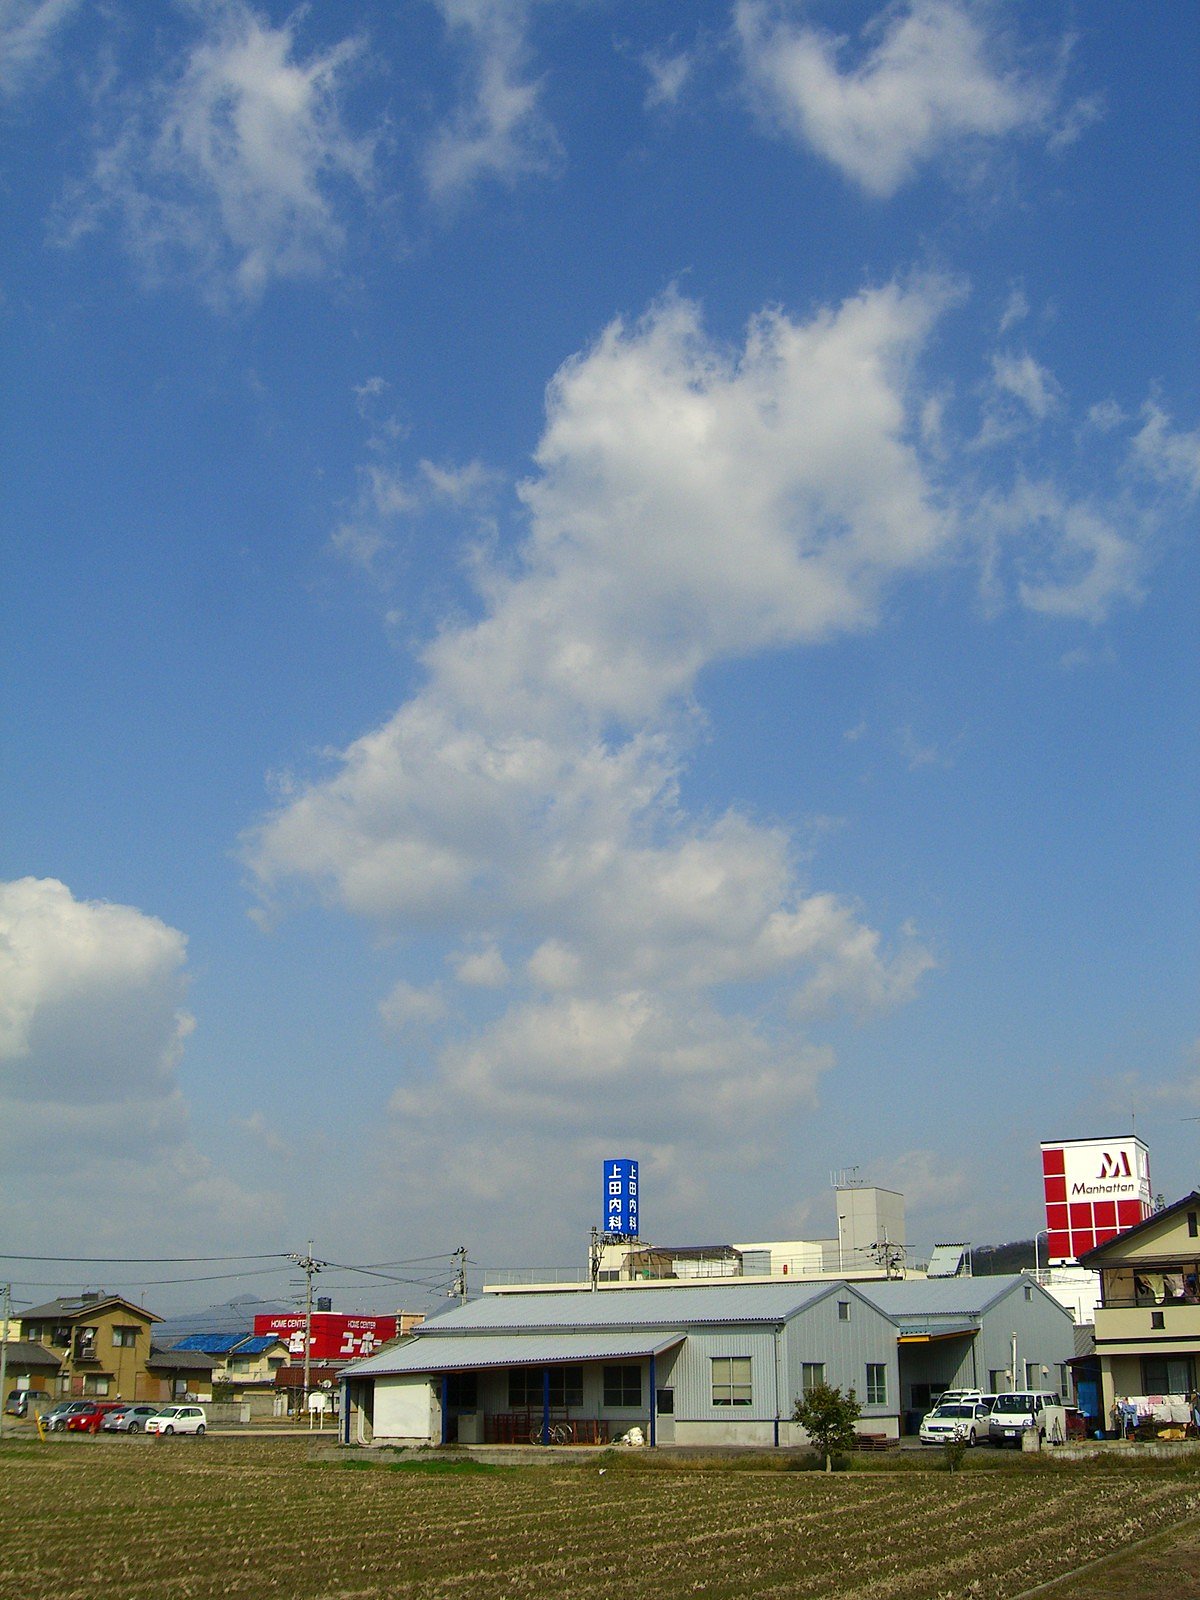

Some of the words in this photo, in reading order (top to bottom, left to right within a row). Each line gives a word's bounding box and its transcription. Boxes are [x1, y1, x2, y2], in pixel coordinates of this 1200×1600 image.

[1072, 1182, 1134, 1195] Manhattan
[608, 1164, 622, 1230] 上田内科
[629, 1165, 637, 1230] 上田内科
[271, 1320, 287, 1328] HOME
[287, 1319, 306, 1328] CENTE
[347, 1320, 360, 1328] HOME
[360, 1321, 376, 1329] CENTER
